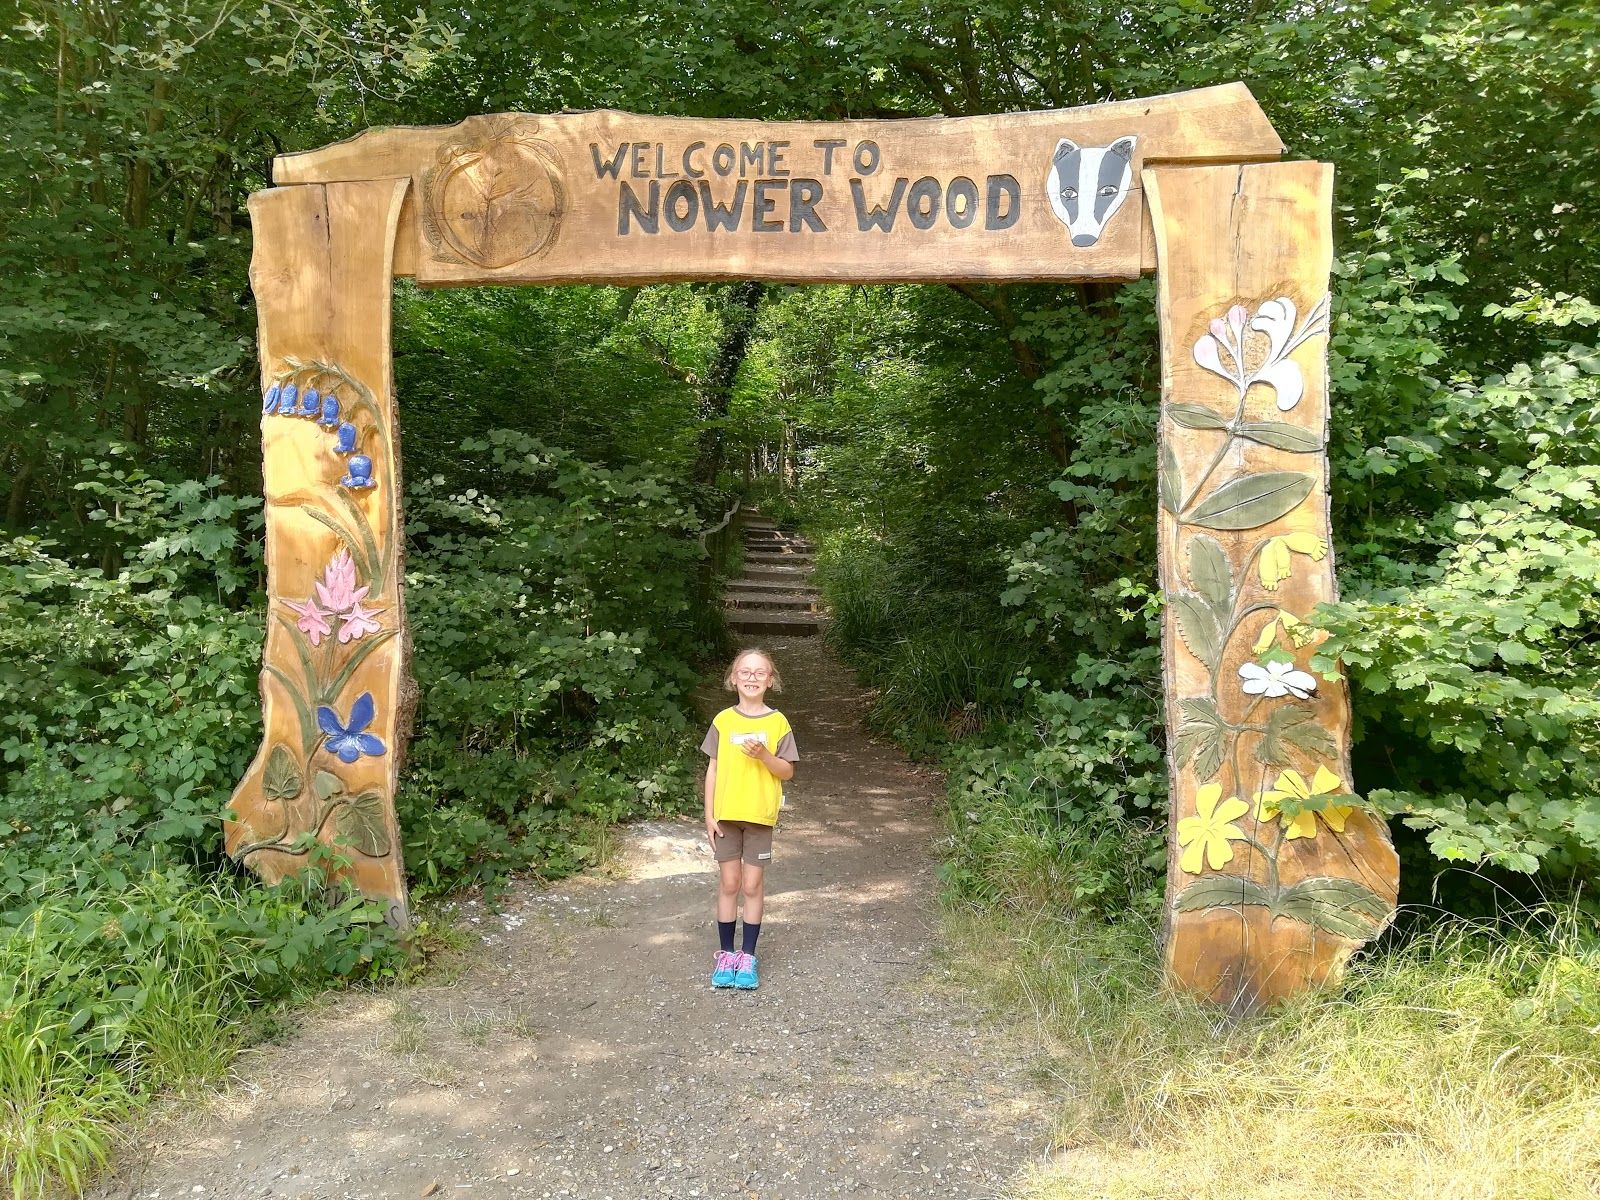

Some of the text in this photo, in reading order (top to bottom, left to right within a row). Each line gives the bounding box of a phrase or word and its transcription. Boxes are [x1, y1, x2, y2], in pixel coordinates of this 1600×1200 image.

[590, 139, 881, 180] WELCOME TO
[617, 173, 1022, 236] NOWER WOOD
